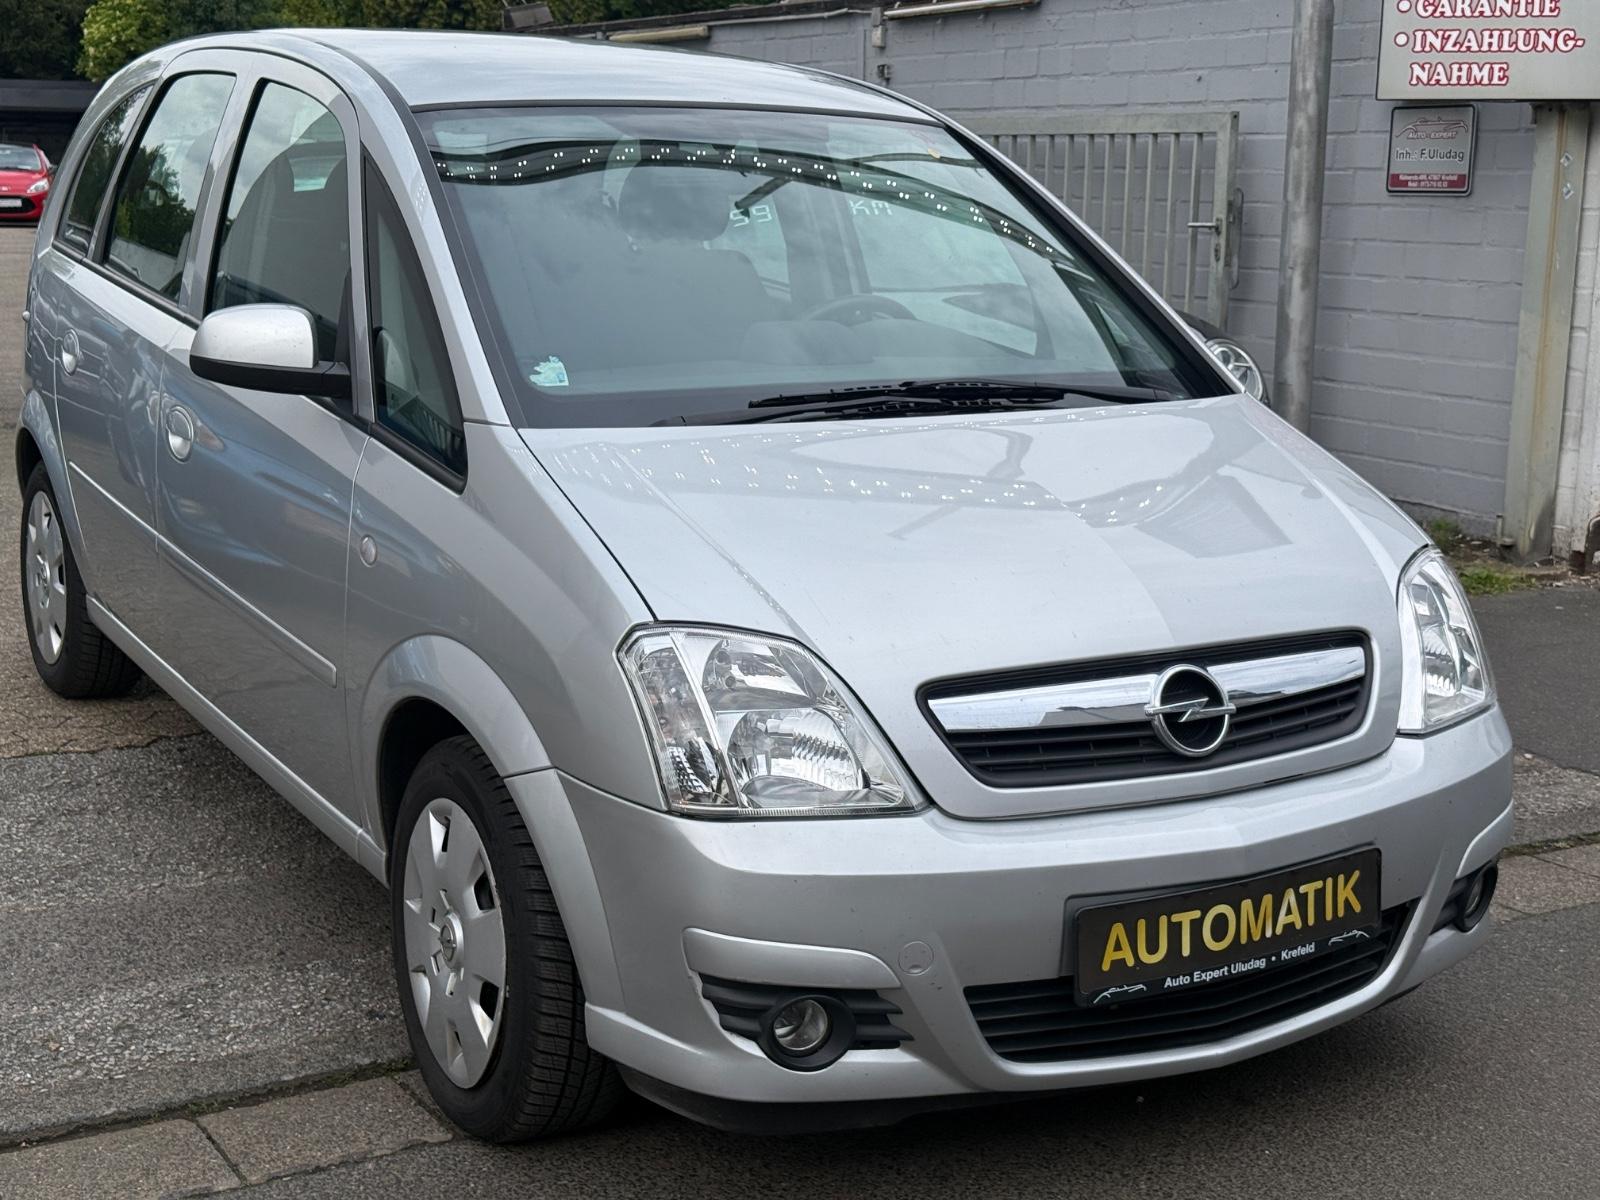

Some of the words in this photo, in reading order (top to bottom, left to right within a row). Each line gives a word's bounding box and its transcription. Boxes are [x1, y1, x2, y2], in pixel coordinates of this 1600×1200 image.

[1416, 0, 1560, 18] GARANTIE
[1412, 28, 1585, 53] INZAHLUNG-
[1409, 62, 1509, 86] NAHME
[1102, 870, 1361, 972] AUTOMATIK
[1164, 975, 1190, 988] Auto
[1193, 966, 1228, 982] Expert
[1231, 957, 1266, 973] Uludag
[1281, 942, 1315, 960] Krefeld
